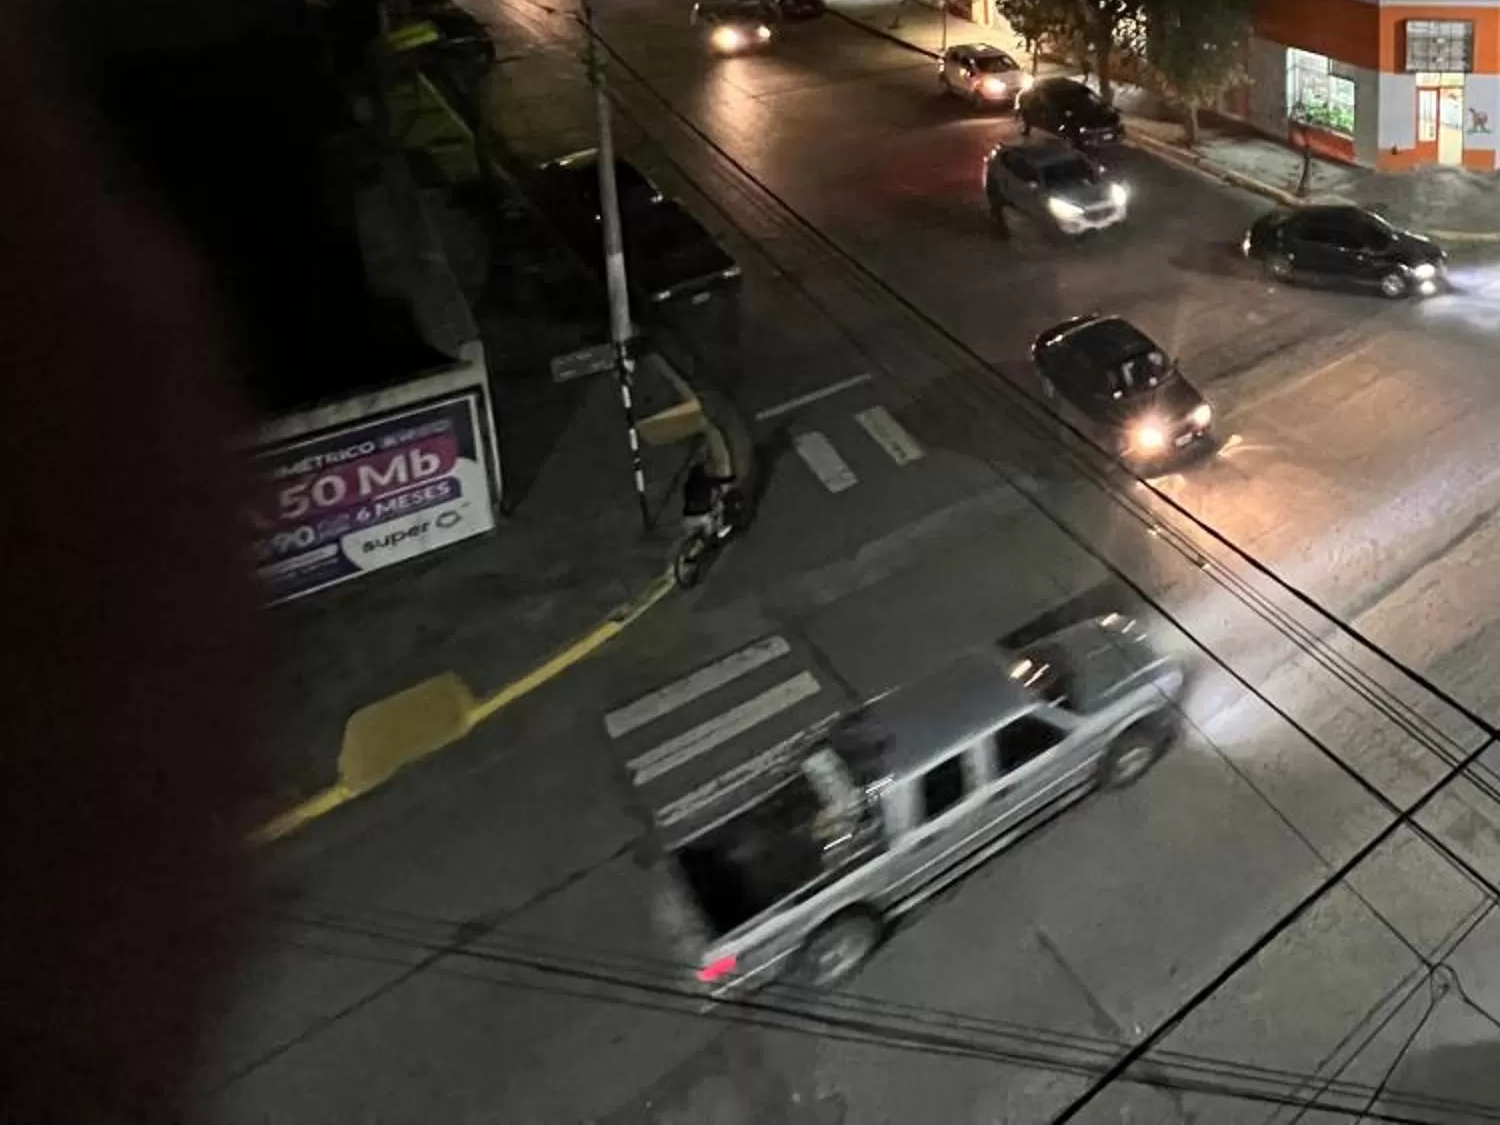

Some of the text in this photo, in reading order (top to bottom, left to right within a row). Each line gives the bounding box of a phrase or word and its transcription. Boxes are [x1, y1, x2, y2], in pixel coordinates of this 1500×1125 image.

[279, 448, 441, 520] 50 Mb
[375, 480, 450, 517] MESES
